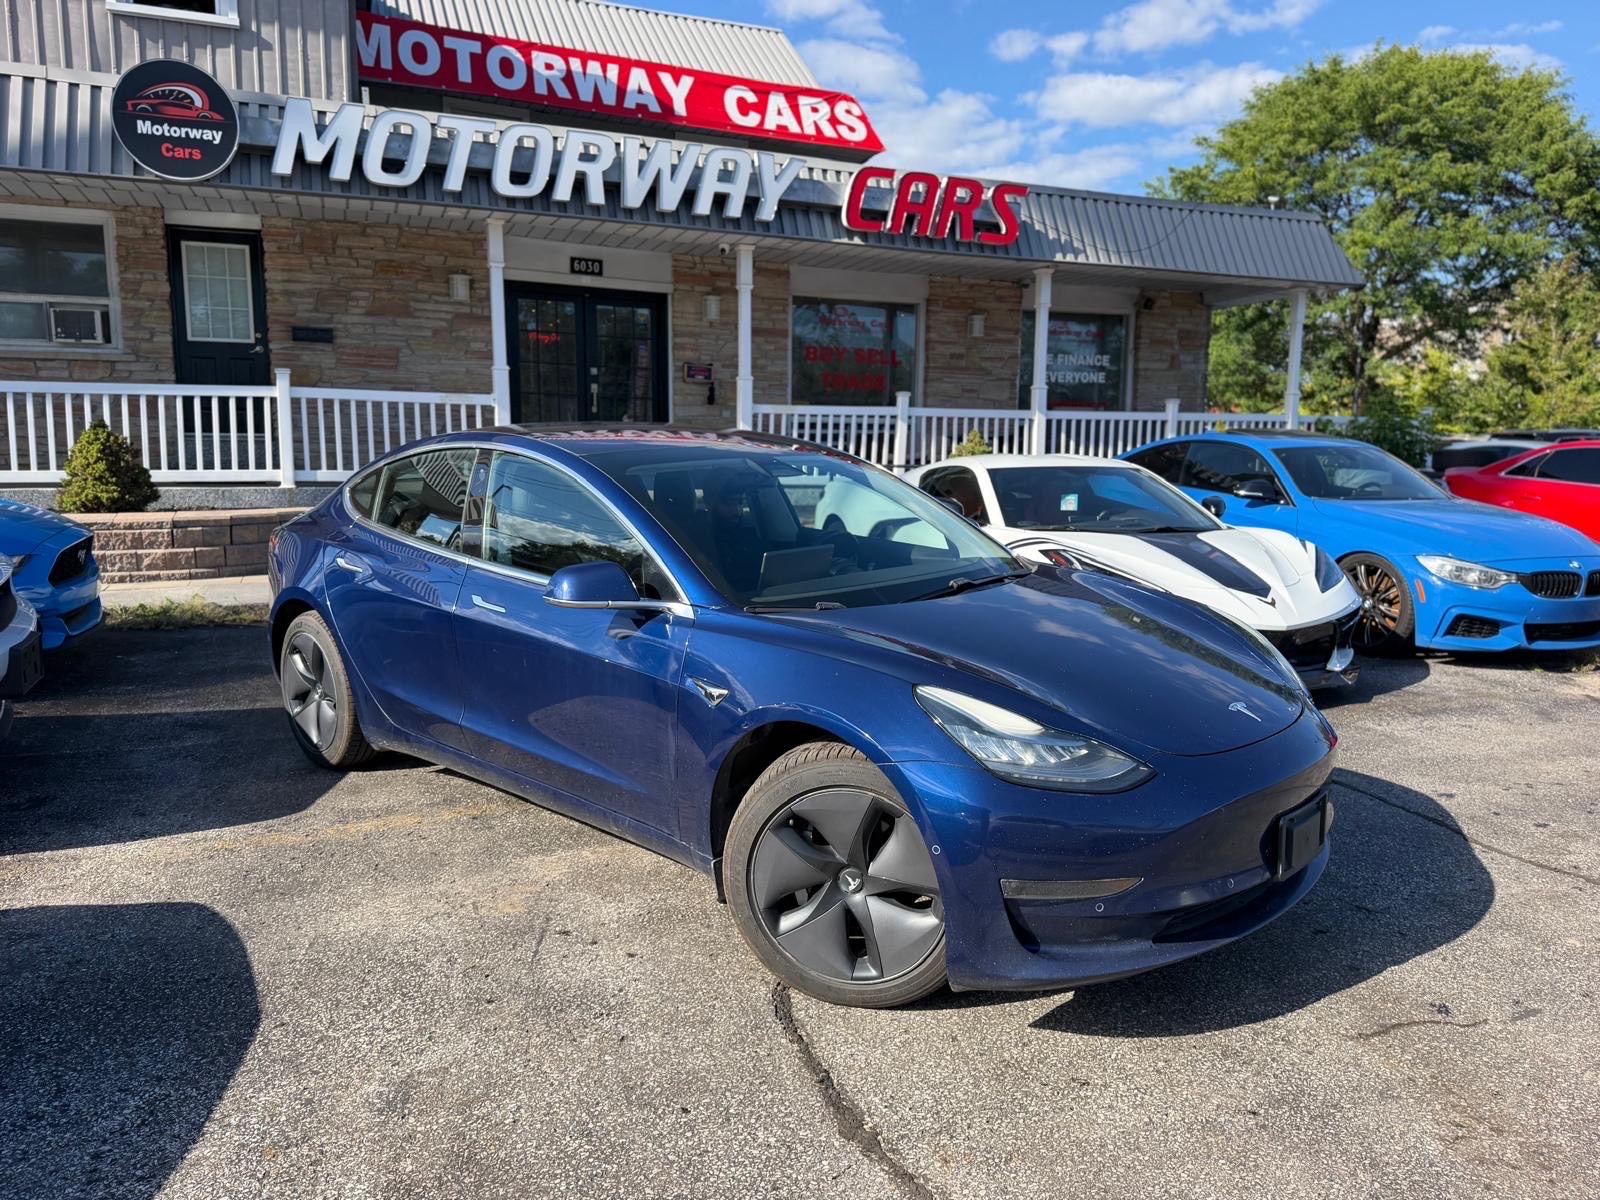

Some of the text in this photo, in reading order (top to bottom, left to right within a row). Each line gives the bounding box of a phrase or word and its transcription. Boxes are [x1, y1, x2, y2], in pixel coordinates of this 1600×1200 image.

[355, 19, 868, 143] MOTORWAY CARS
[136, 119, 223, 144] Motorway
[161, 143, 202, 160] Cars
[271, 97, 1030, 245] MOTORWAY CARS
[574, 259, 600, 273] 6030
[805, 345, 902, 368] BUY SELL
[1057, 353, 1111, 367] FINANCE
